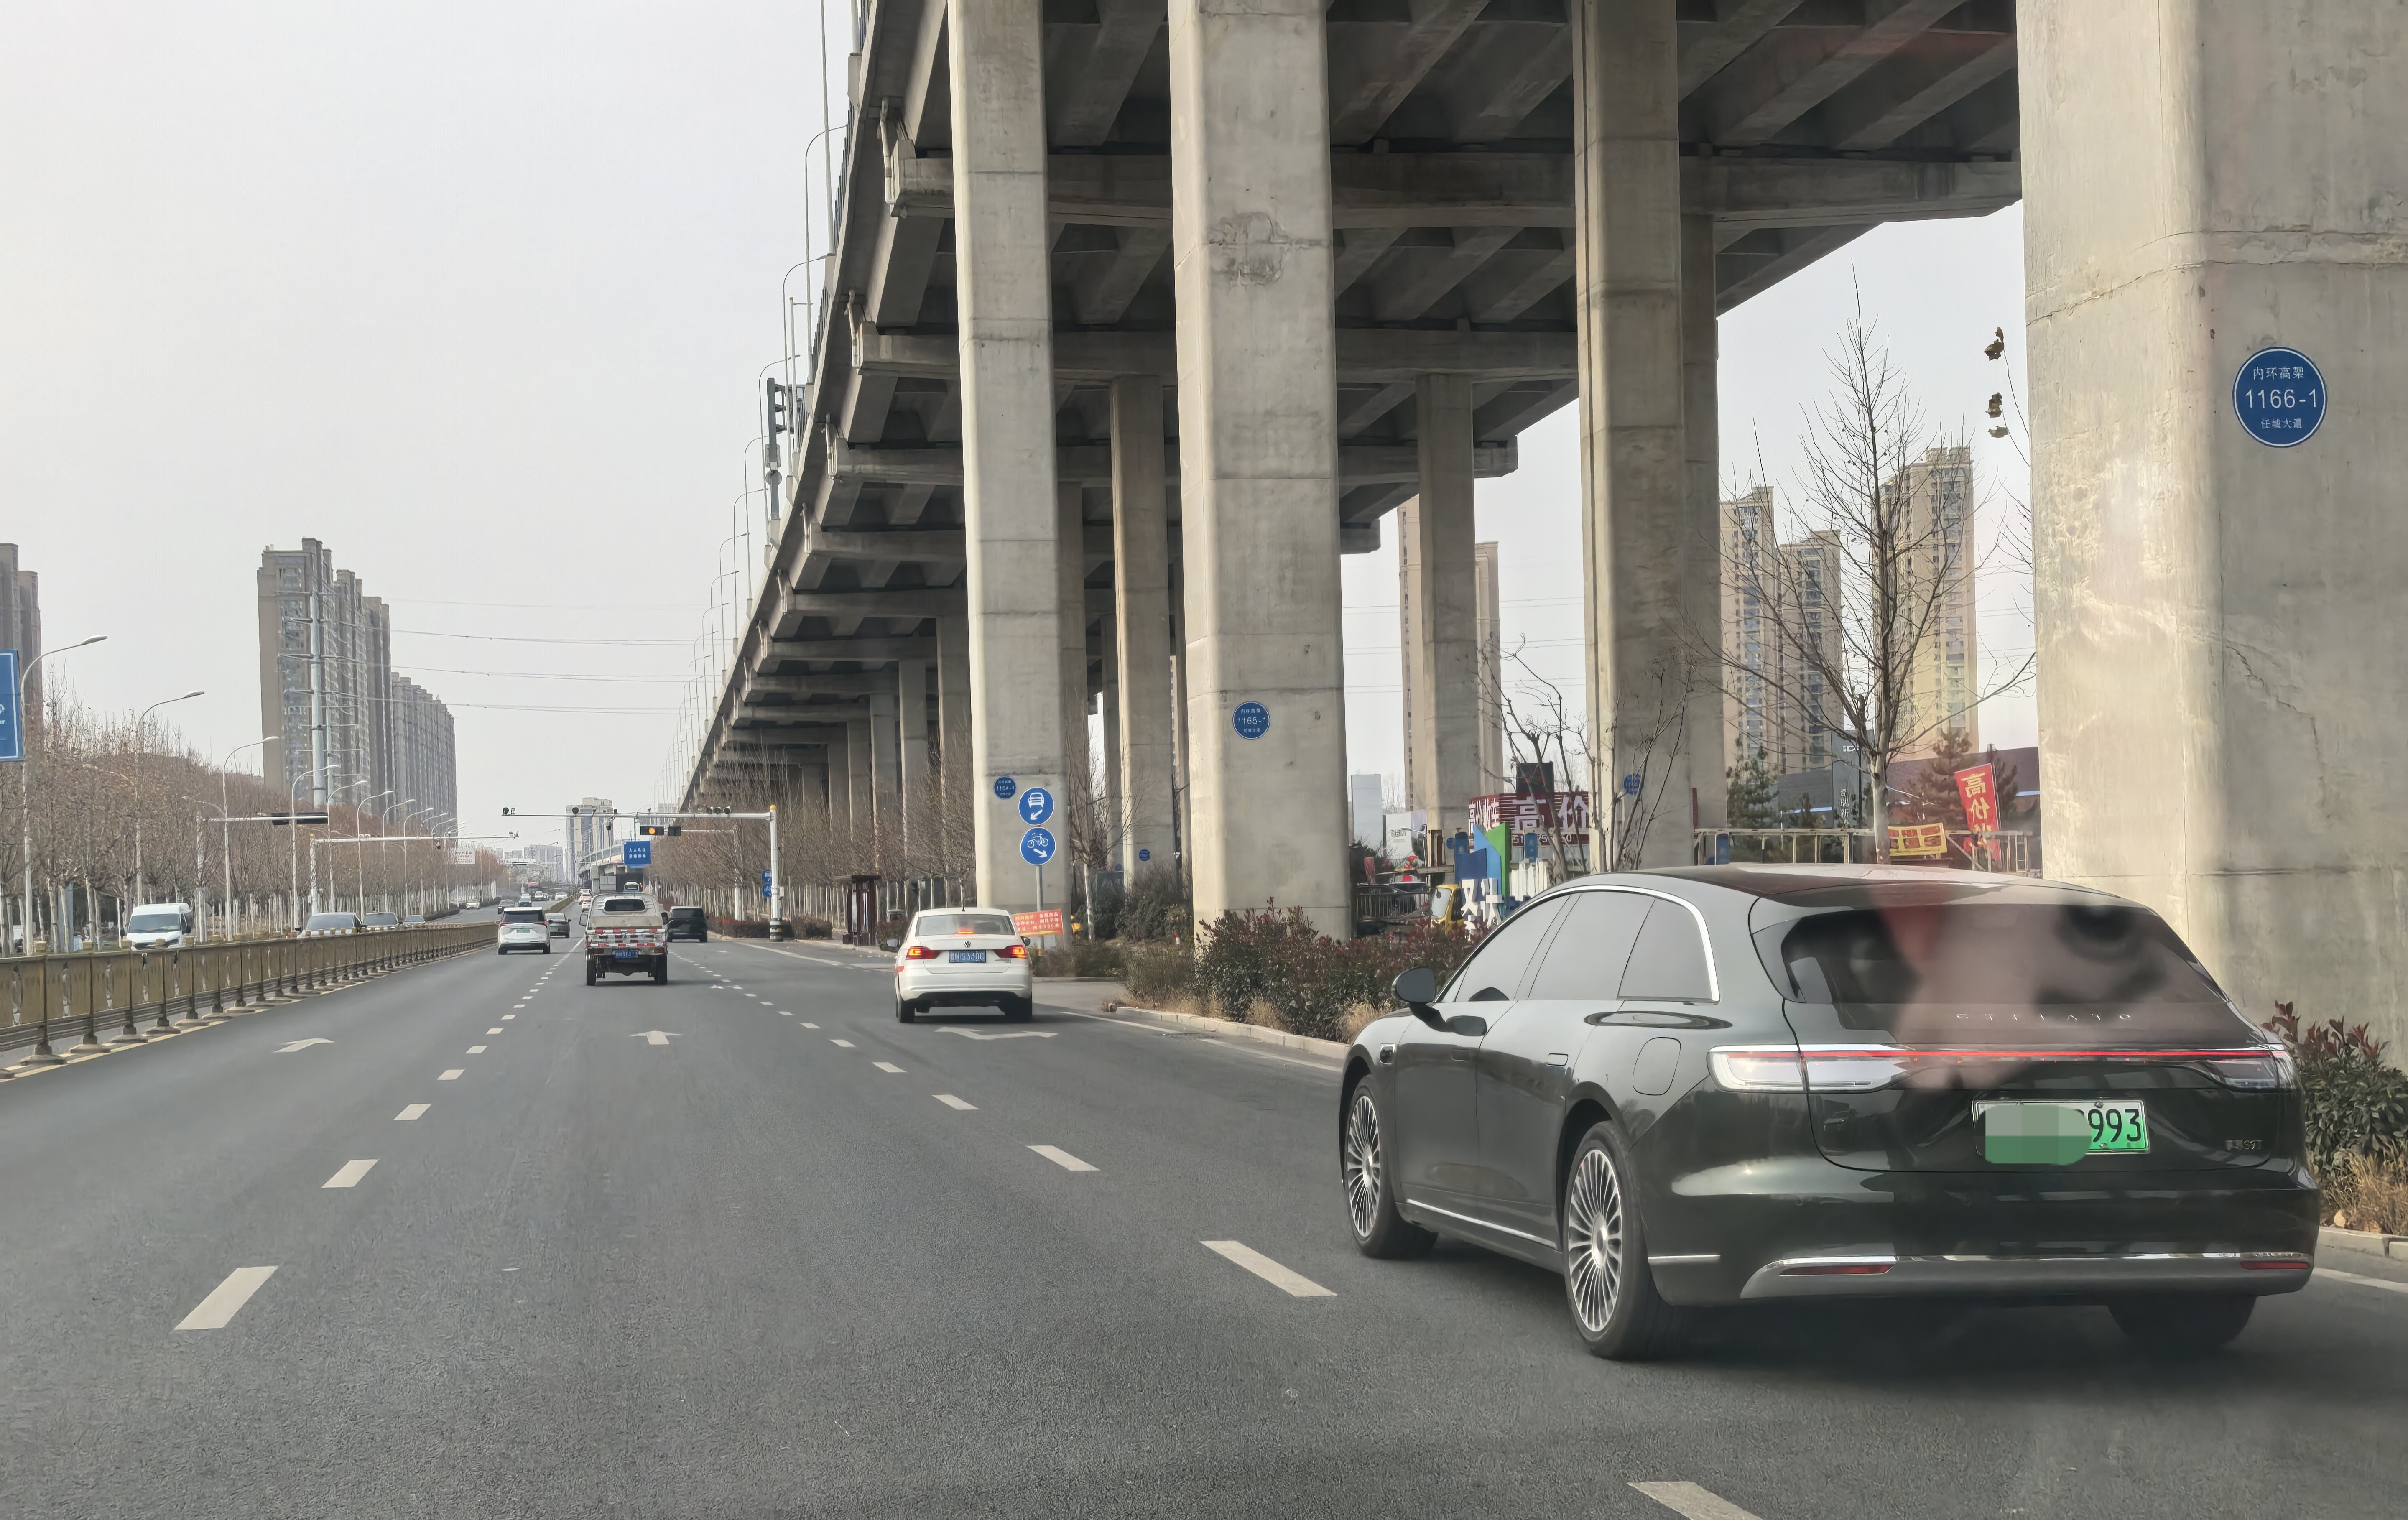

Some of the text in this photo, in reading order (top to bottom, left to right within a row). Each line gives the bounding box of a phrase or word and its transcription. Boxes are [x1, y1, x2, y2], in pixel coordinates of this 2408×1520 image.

[2253, 366, 2304, 380] 内环高架
[2245, 388, 2316, 408] 1166-1
[1238, 717, 1266, 725] 1165-1
[2073, 1109, 2141, 1142] 993
